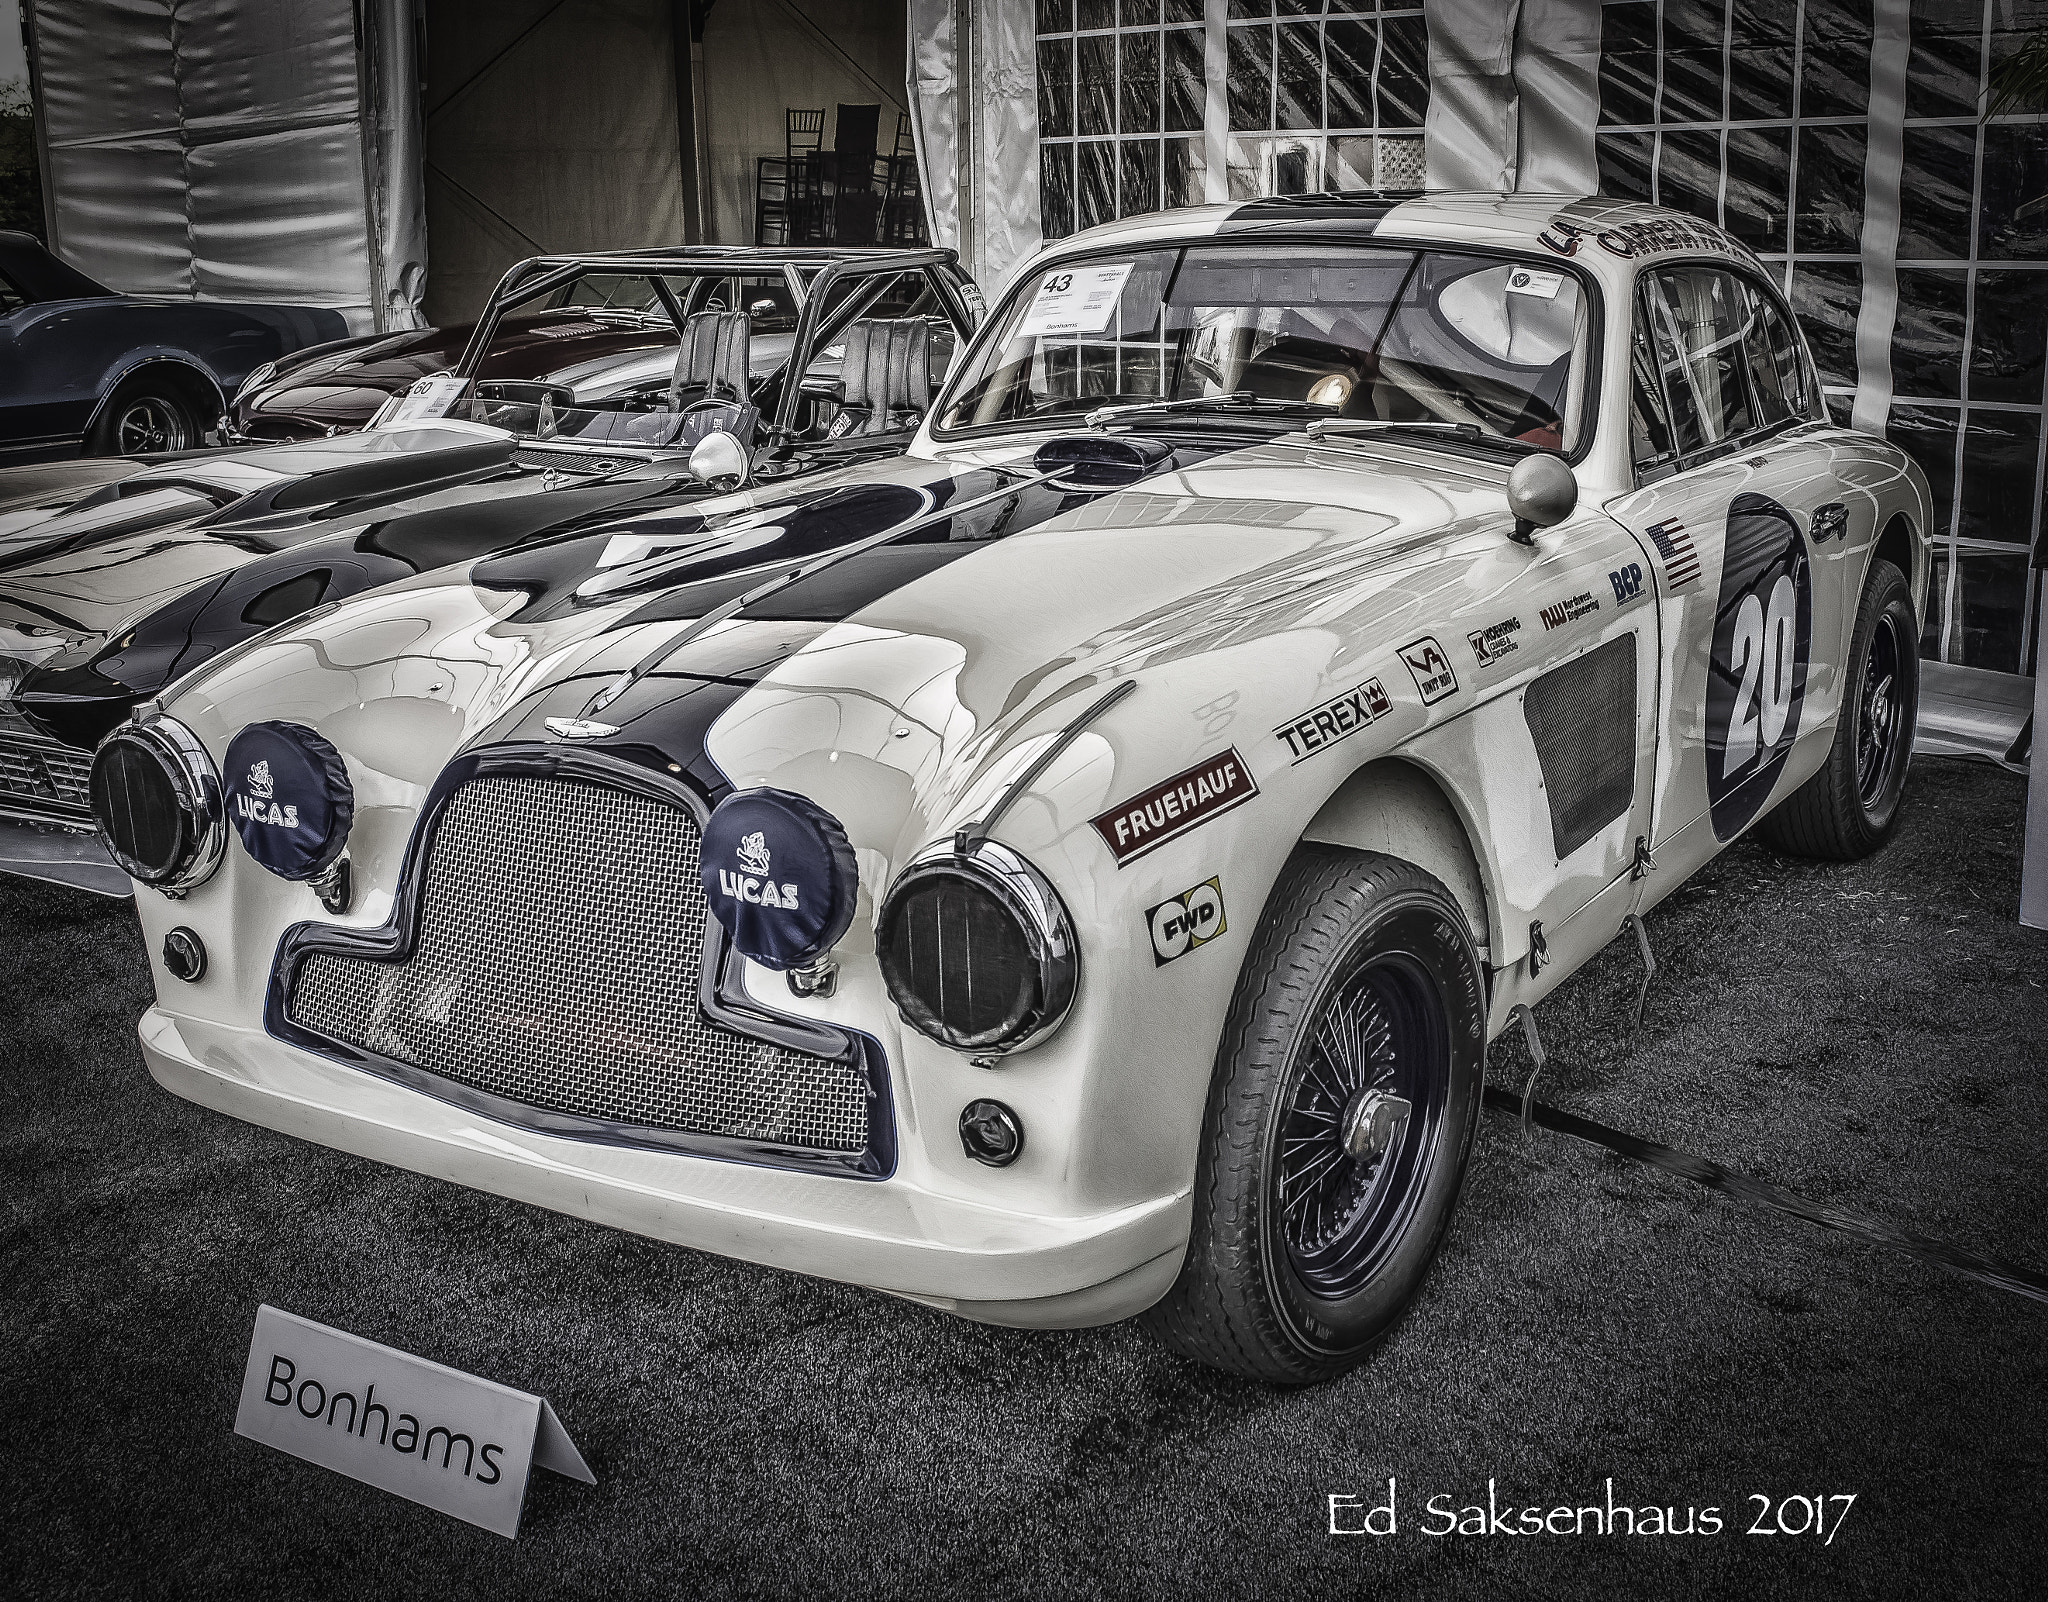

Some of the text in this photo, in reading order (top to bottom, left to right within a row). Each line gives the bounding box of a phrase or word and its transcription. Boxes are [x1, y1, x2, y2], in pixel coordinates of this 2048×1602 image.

[1043, 273, 1074, 293] 43
[413, 381, 434, 395] 60
[1482, 616, 1521, 643] KOEHRING
[1421, 671, 1452, 696] UNIT RIG
[1722, 574, 1796, 780] 20
[1275, 692, 1371, 758] TEREX
[236, 793, 300, 829] LUCAS
[1113, 762, 1237, 847] FRUEHAUF
[719, 869, 799, 910] LUCAS
[1162, 902, 1216, 942] FWD
[264, 1354, 505, 1486] Bonhams
